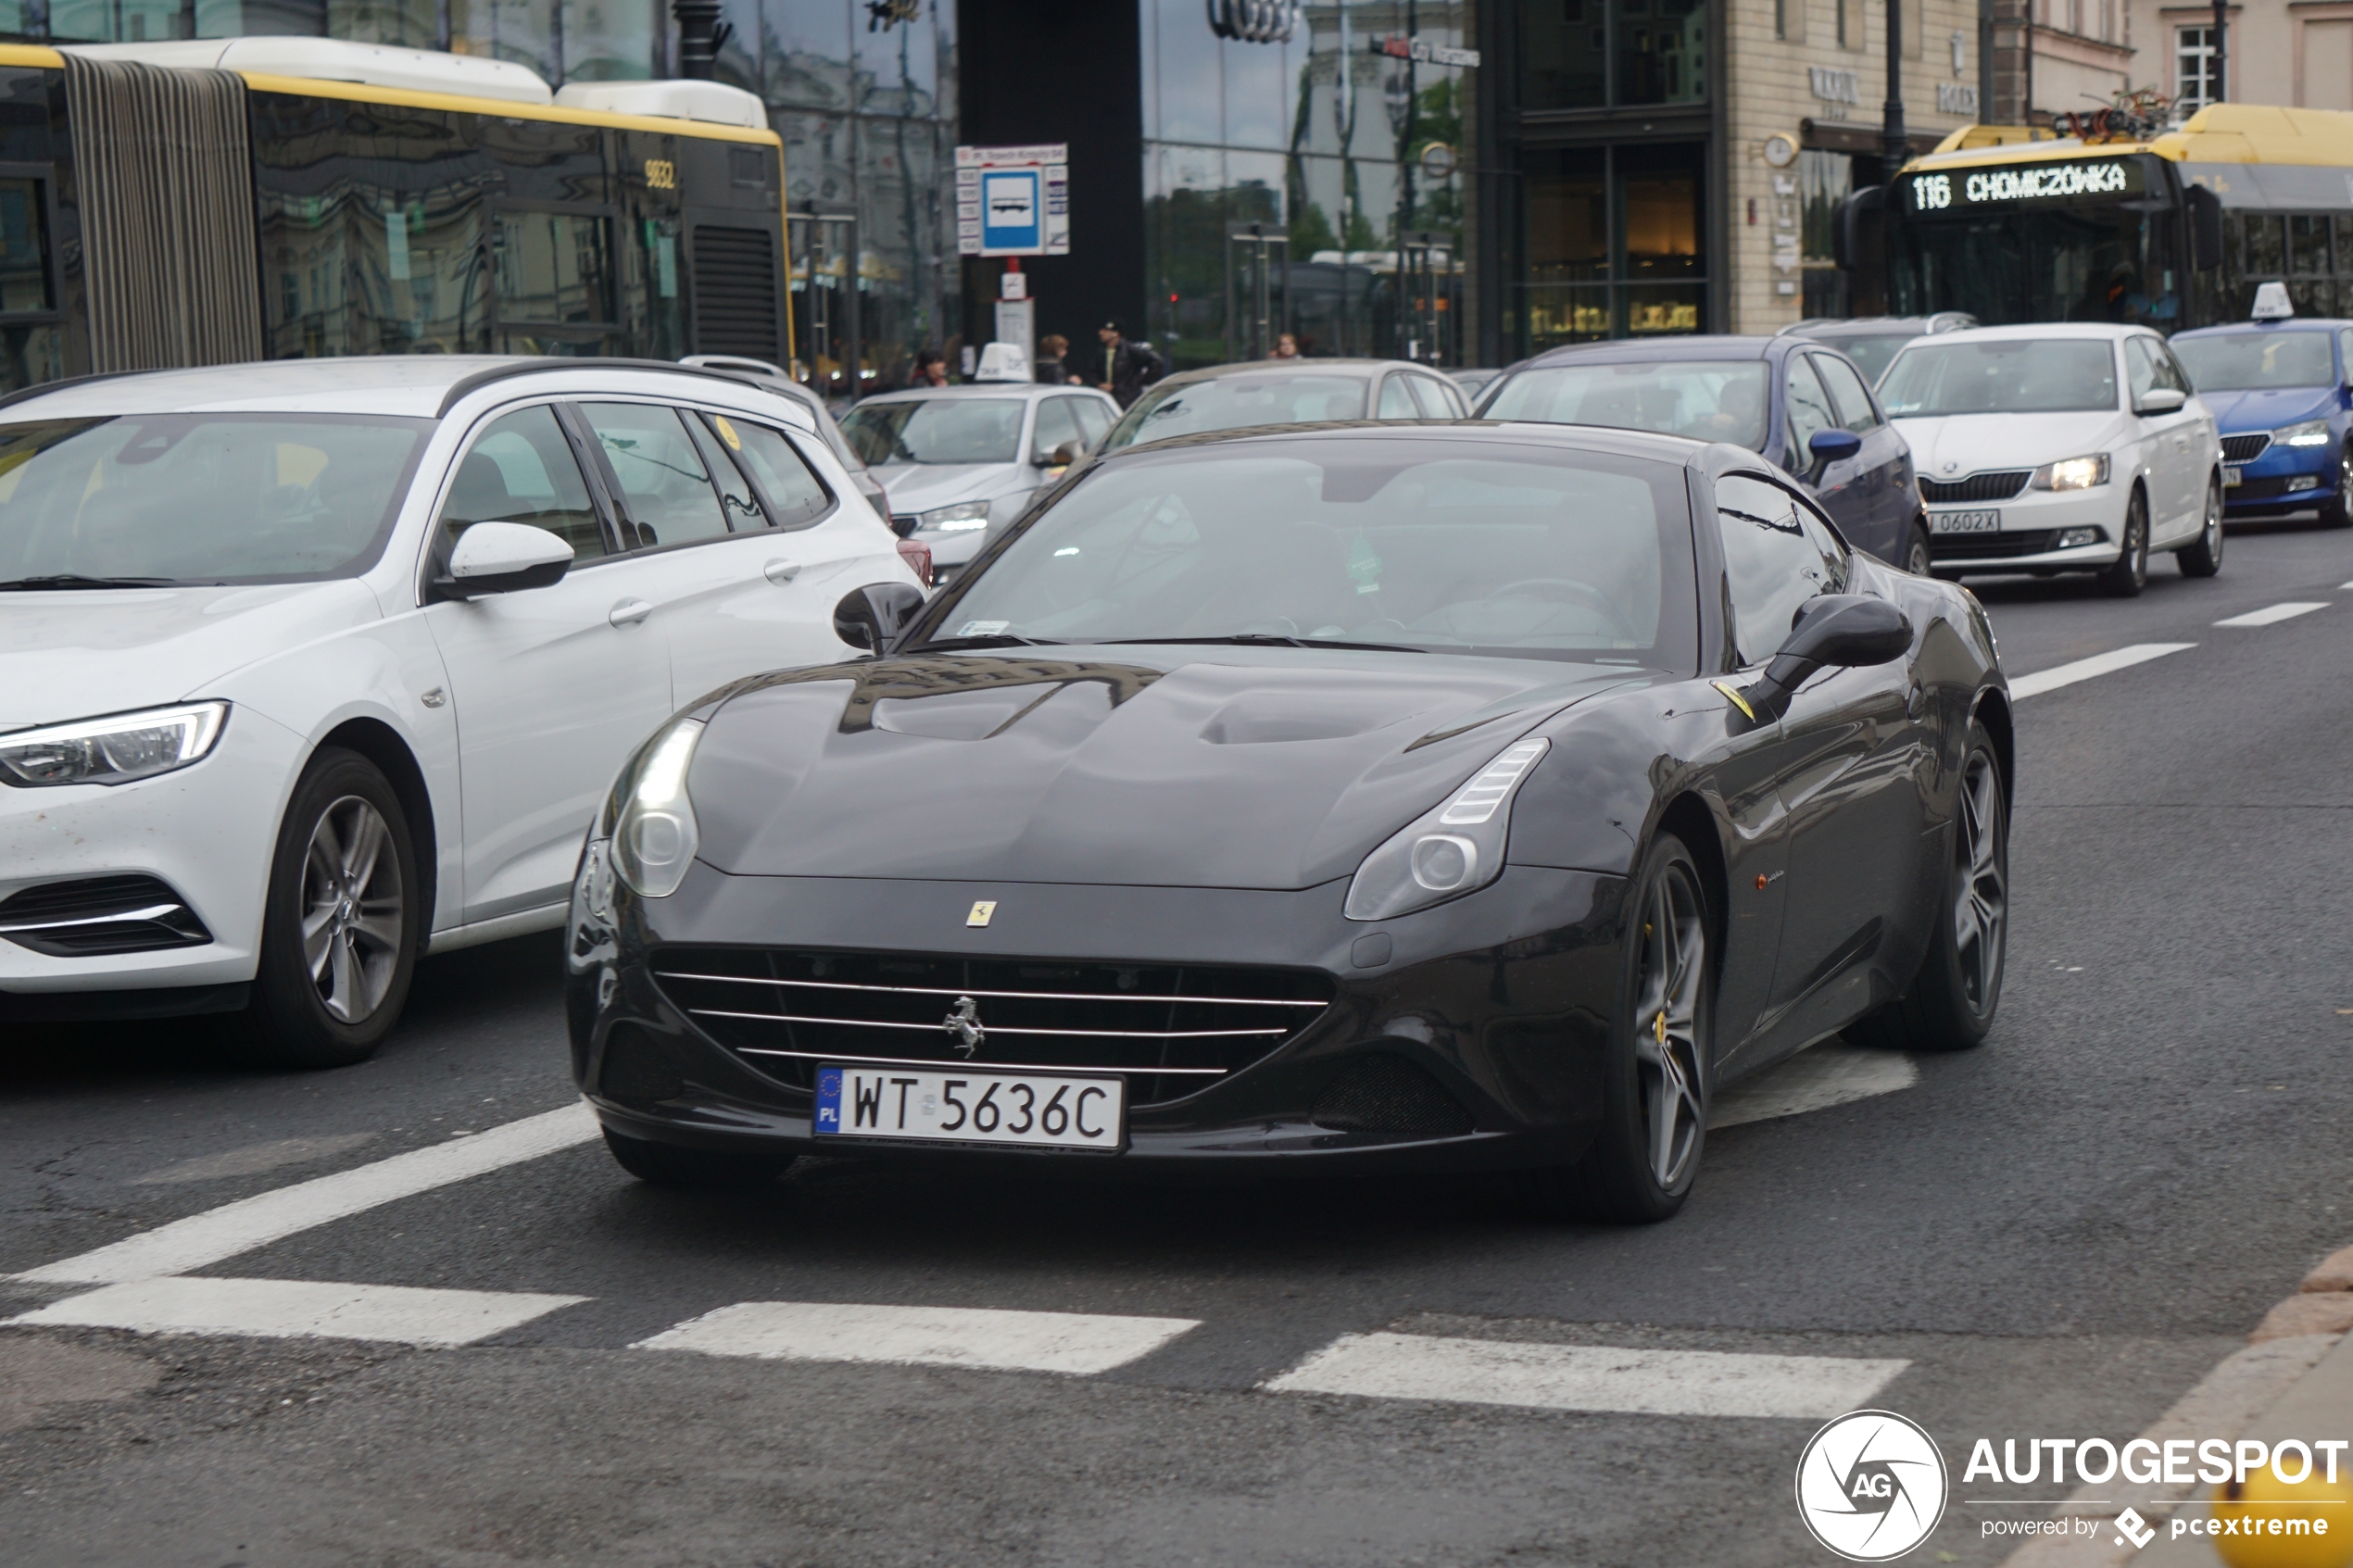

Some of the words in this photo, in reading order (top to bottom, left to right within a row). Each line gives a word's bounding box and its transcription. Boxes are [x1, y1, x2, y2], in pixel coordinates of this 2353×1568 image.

[1912, 174, 1952, 209] 116
[1966, 163, 2126, 202] CHOMICZÓWKA
[1941, 513, 1995, 531] 0602X
[819, 1107, 838, 1123] PL
[854, 1076, 919, 1129] WT
[940, 1079, 1107, 1138] 5636C
